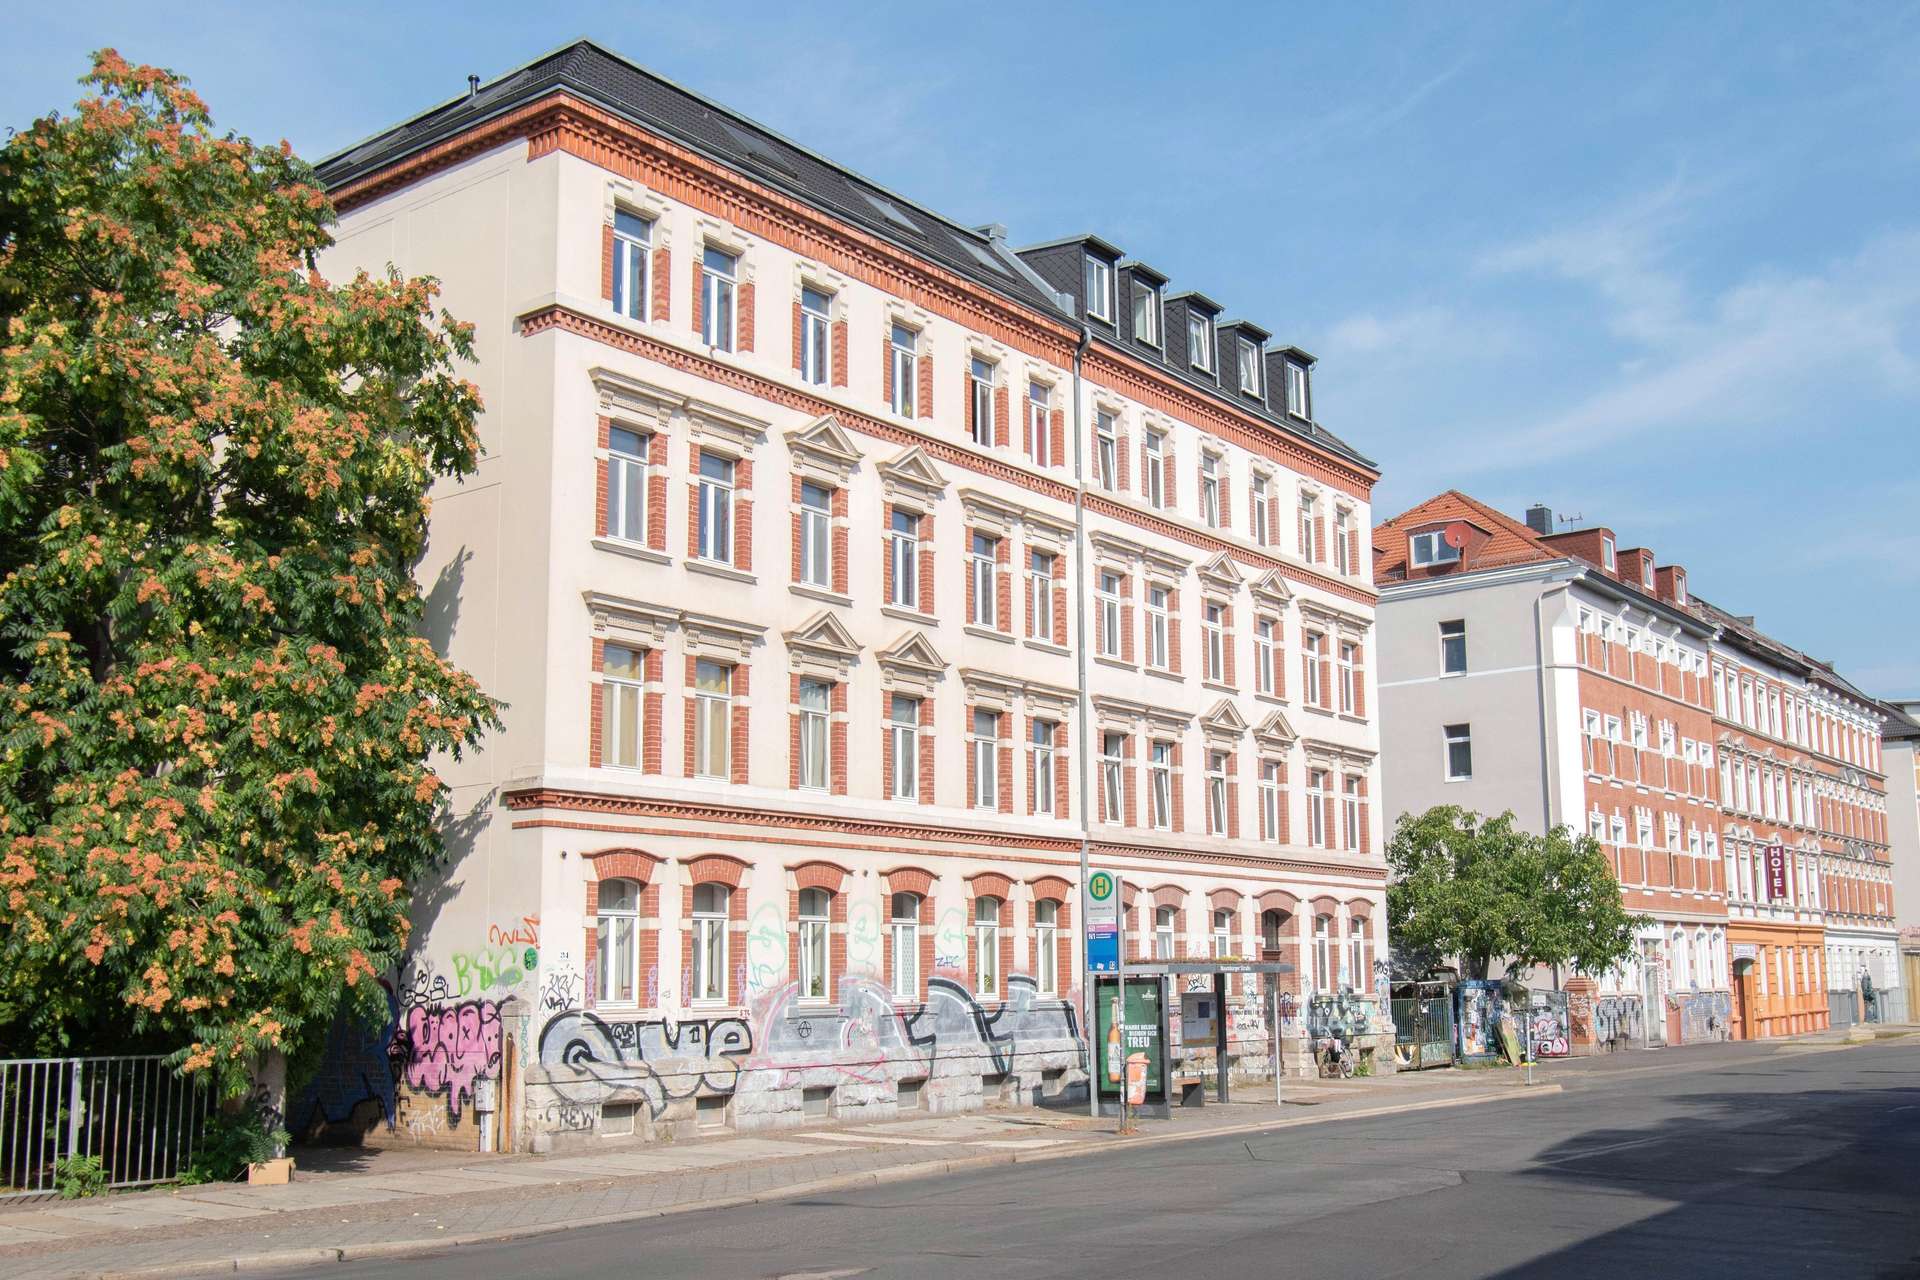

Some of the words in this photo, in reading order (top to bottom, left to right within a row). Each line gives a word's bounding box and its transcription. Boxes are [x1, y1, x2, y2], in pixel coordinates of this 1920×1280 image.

[1770, 847, 1783, 897] HOTEL
[1095, 878, 1106, 896] H
[1127, 1036, 1150, 1048] TREU
